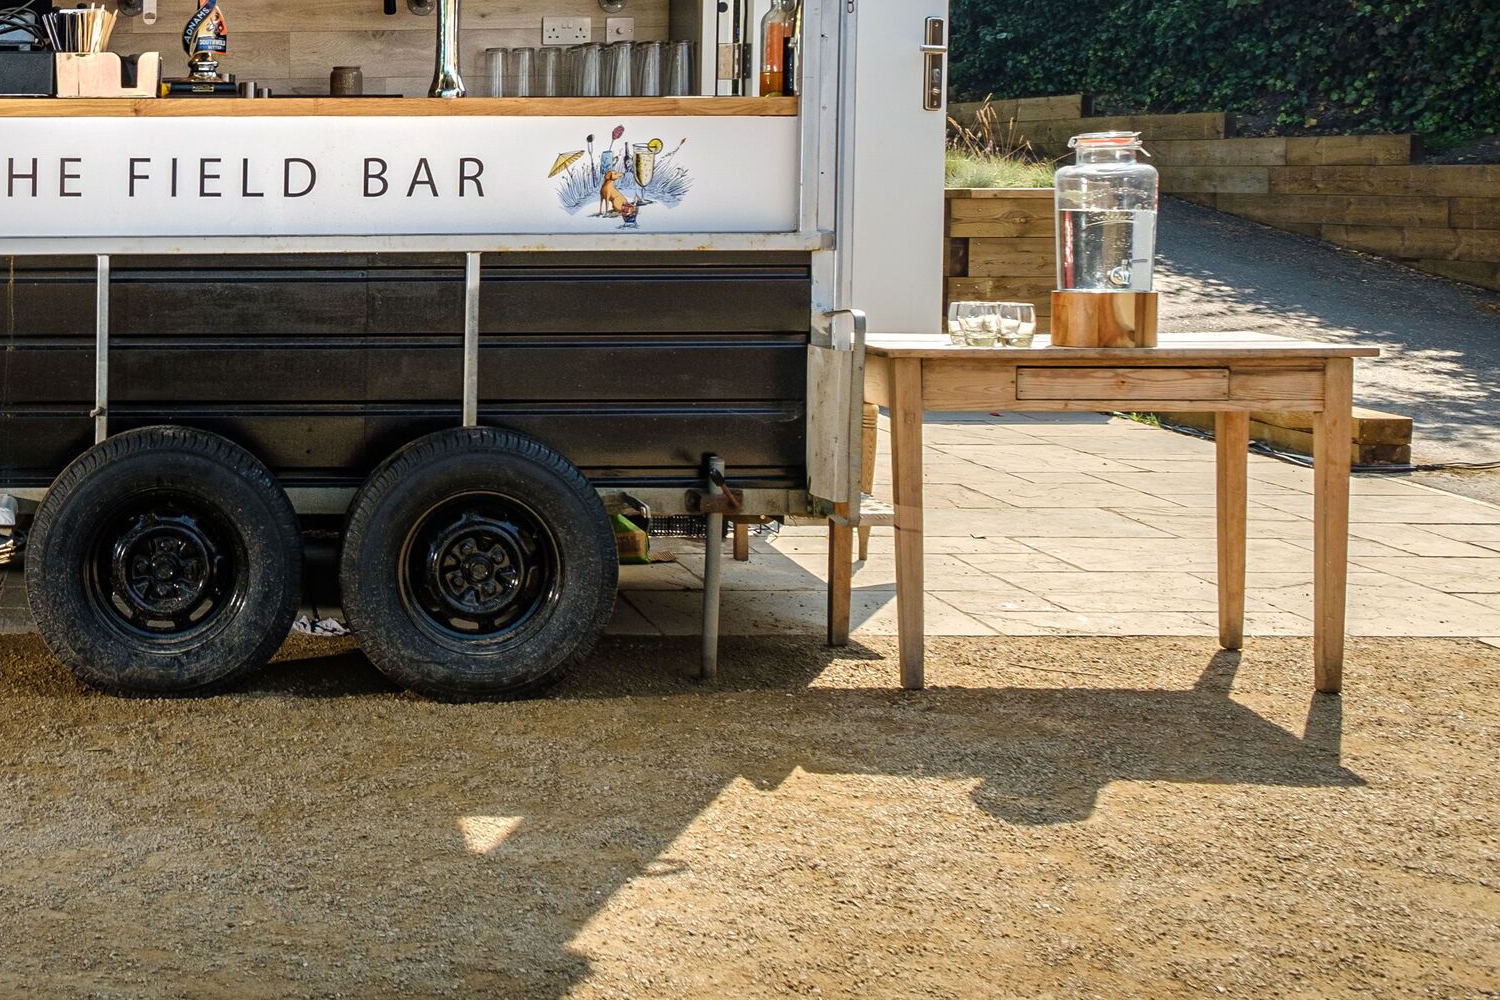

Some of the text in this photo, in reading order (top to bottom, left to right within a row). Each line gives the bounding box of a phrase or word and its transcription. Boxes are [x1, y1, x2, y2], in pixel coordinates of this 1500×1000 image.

[184, 7, 210, 44] ADNAMS
[128, 157, 317, 198] FIELD
[363, 157, 485, 198] BAR
